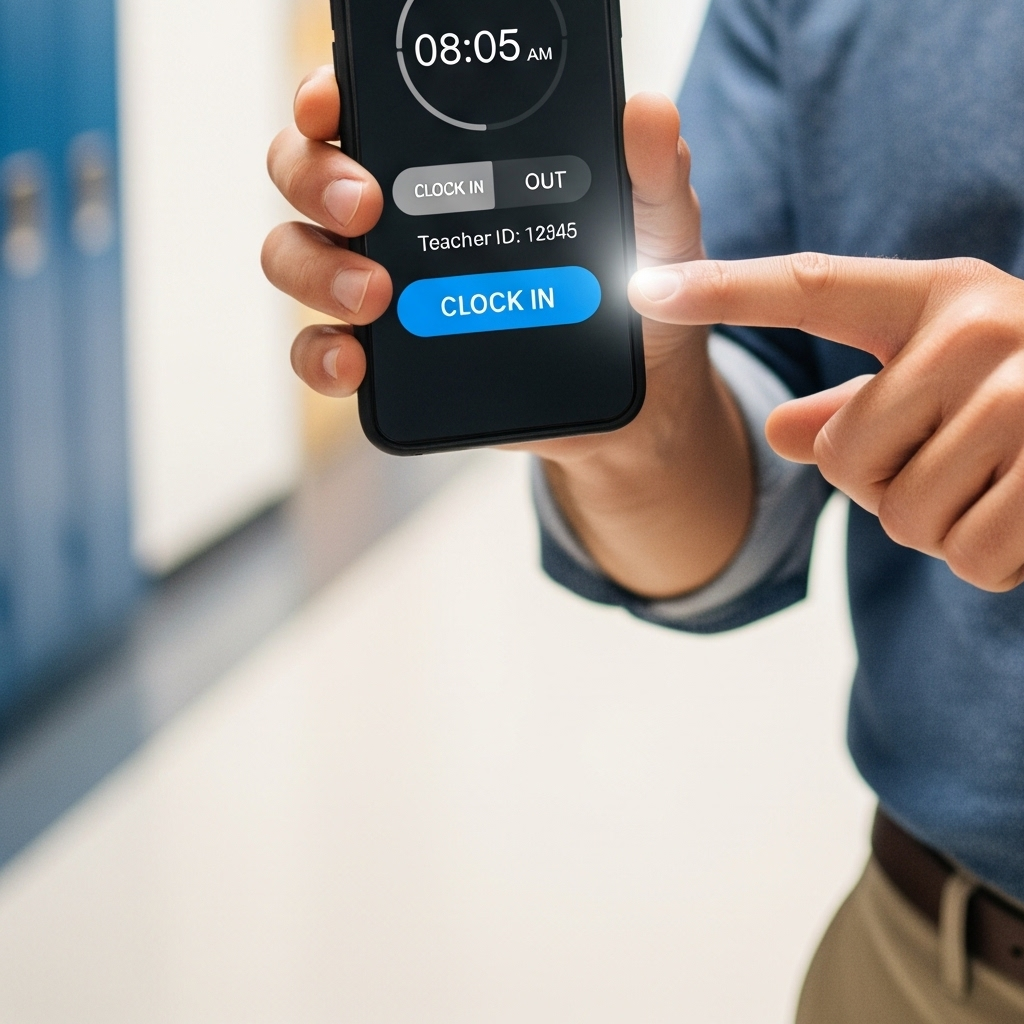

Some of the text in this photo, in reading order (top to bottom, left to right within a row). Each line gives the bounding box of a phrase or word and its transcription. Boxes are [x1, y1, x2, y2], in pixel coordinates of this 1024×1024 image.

[414, 28, 553, 67] 08:05 AM
[414, 180, 485, 198] CLOCK IN
[525, 171, 567, 191] OUT
[417, 232, 492, 252] Teacher
[496, 228, 521, 245] ID:
[441, 287, 555, 317] CLOCK IN
